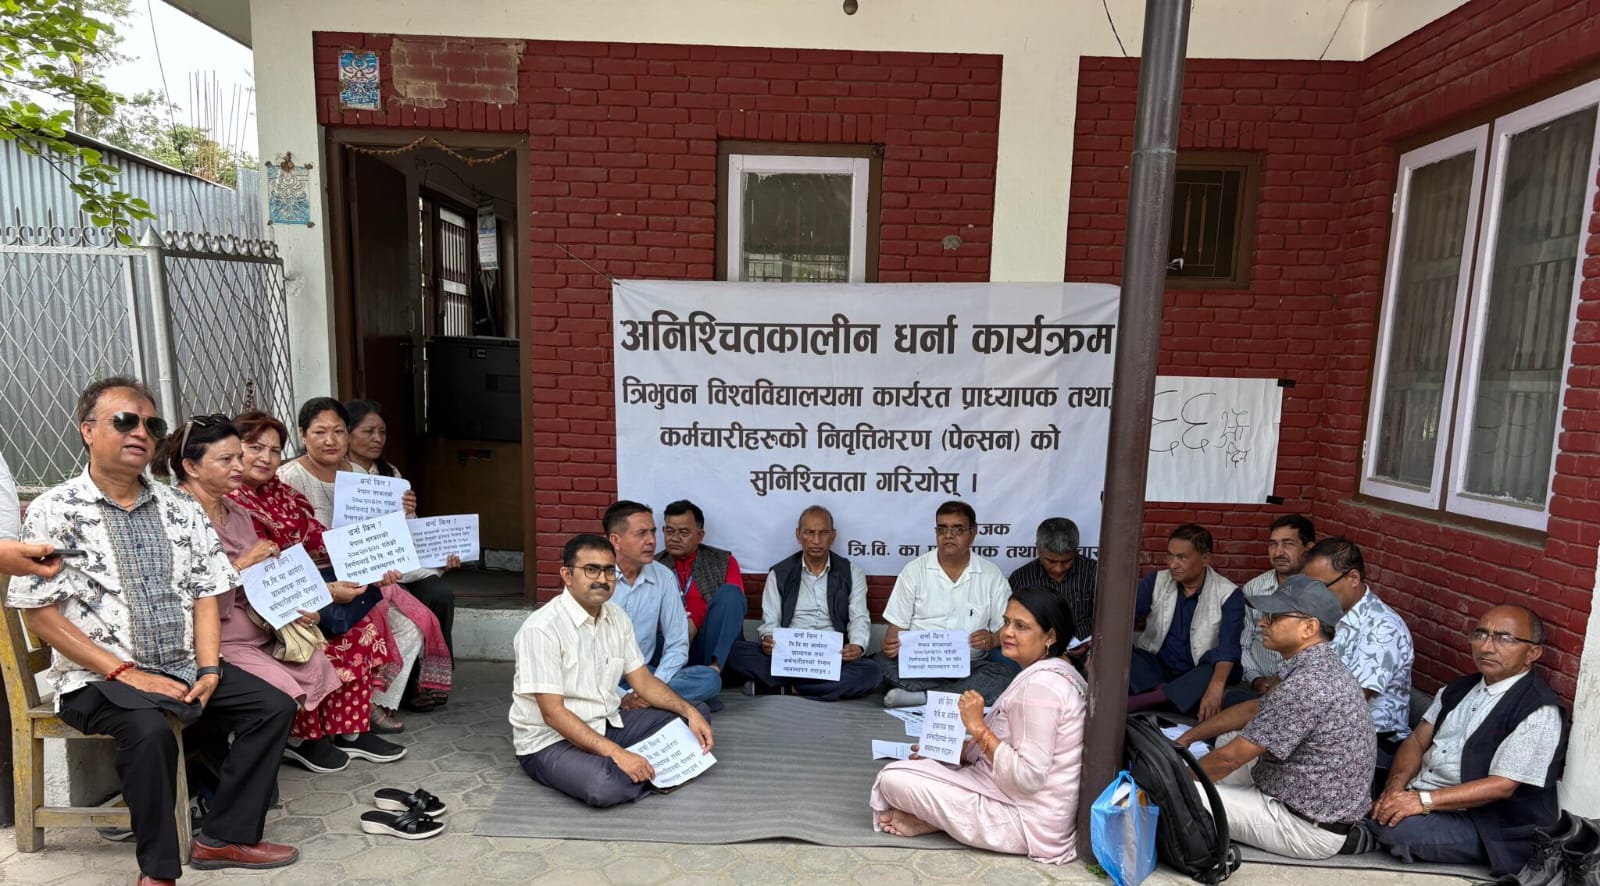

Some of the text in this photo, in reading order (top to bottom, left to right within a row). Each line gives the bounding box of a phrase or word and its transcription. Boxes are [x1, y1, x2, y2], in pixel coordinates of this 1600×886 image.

[620, 309, 1115, 356] अनिश्चितकालीन धर्ना कार्यक्रम
[622, 376, 698, 410] त्रिभुवन
[707, 378, 864, 407] विश्वविद्यालयमा
[872, 381, 952, 408] कार्यरत
[961, 387, 1059, 410] प्राध्यापक
[817, 421, 932, 455] निवृत्तिभरण
[941, 423, 1020, 452] (पेन्सन)
[1030, 423, 1061, 450] को
[750, 463, 867, 496] सुनिश्चितता
[876, 465, 961, 497] गरियोस्
[848, 540, 891, 556] त्रि.वि.
[898, 545, 921, 558] का
